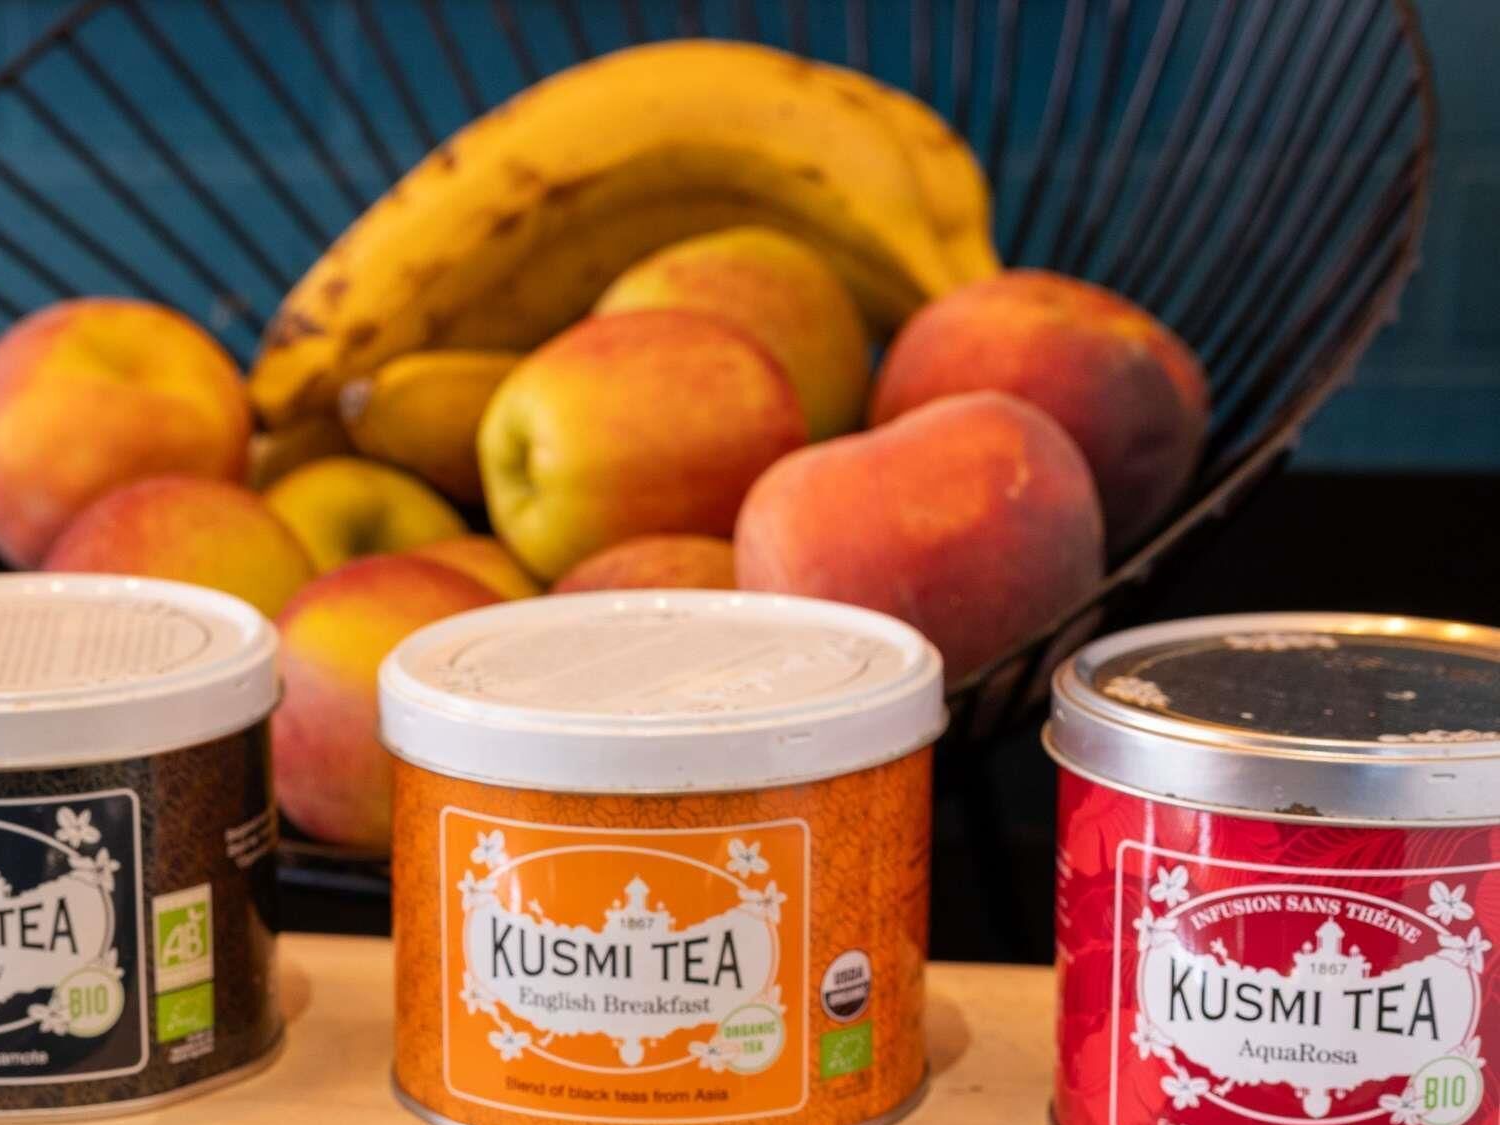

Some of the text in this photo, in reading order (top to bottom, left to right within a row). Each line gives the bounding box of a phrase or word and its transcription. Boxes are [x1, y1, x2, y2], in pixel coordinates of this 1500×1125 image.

[620, 918, 654, 930] 1867
[1191, 896, 1422, 944] INFUSION SANS THÉINE
[492, 916, 743, 989] KUSMI TEA
[1310, 963, 1348, 976] 1867
[68, 985, 108, 1019] BIO
[519, 987, 710, 1015] English Breakfast
[1169, 957, 1439, 1041] KUSMI TEA
[724, 1020, 776, 1038] ORGANIC
[743, 1042, 763, 1054] TEA
[1239, 1040, 1358, 1066] AquaRosa
[506, 1076, 728, 1102] Blend of black teas from Asia
[1424, 1075, 1466, 1110] BIO
